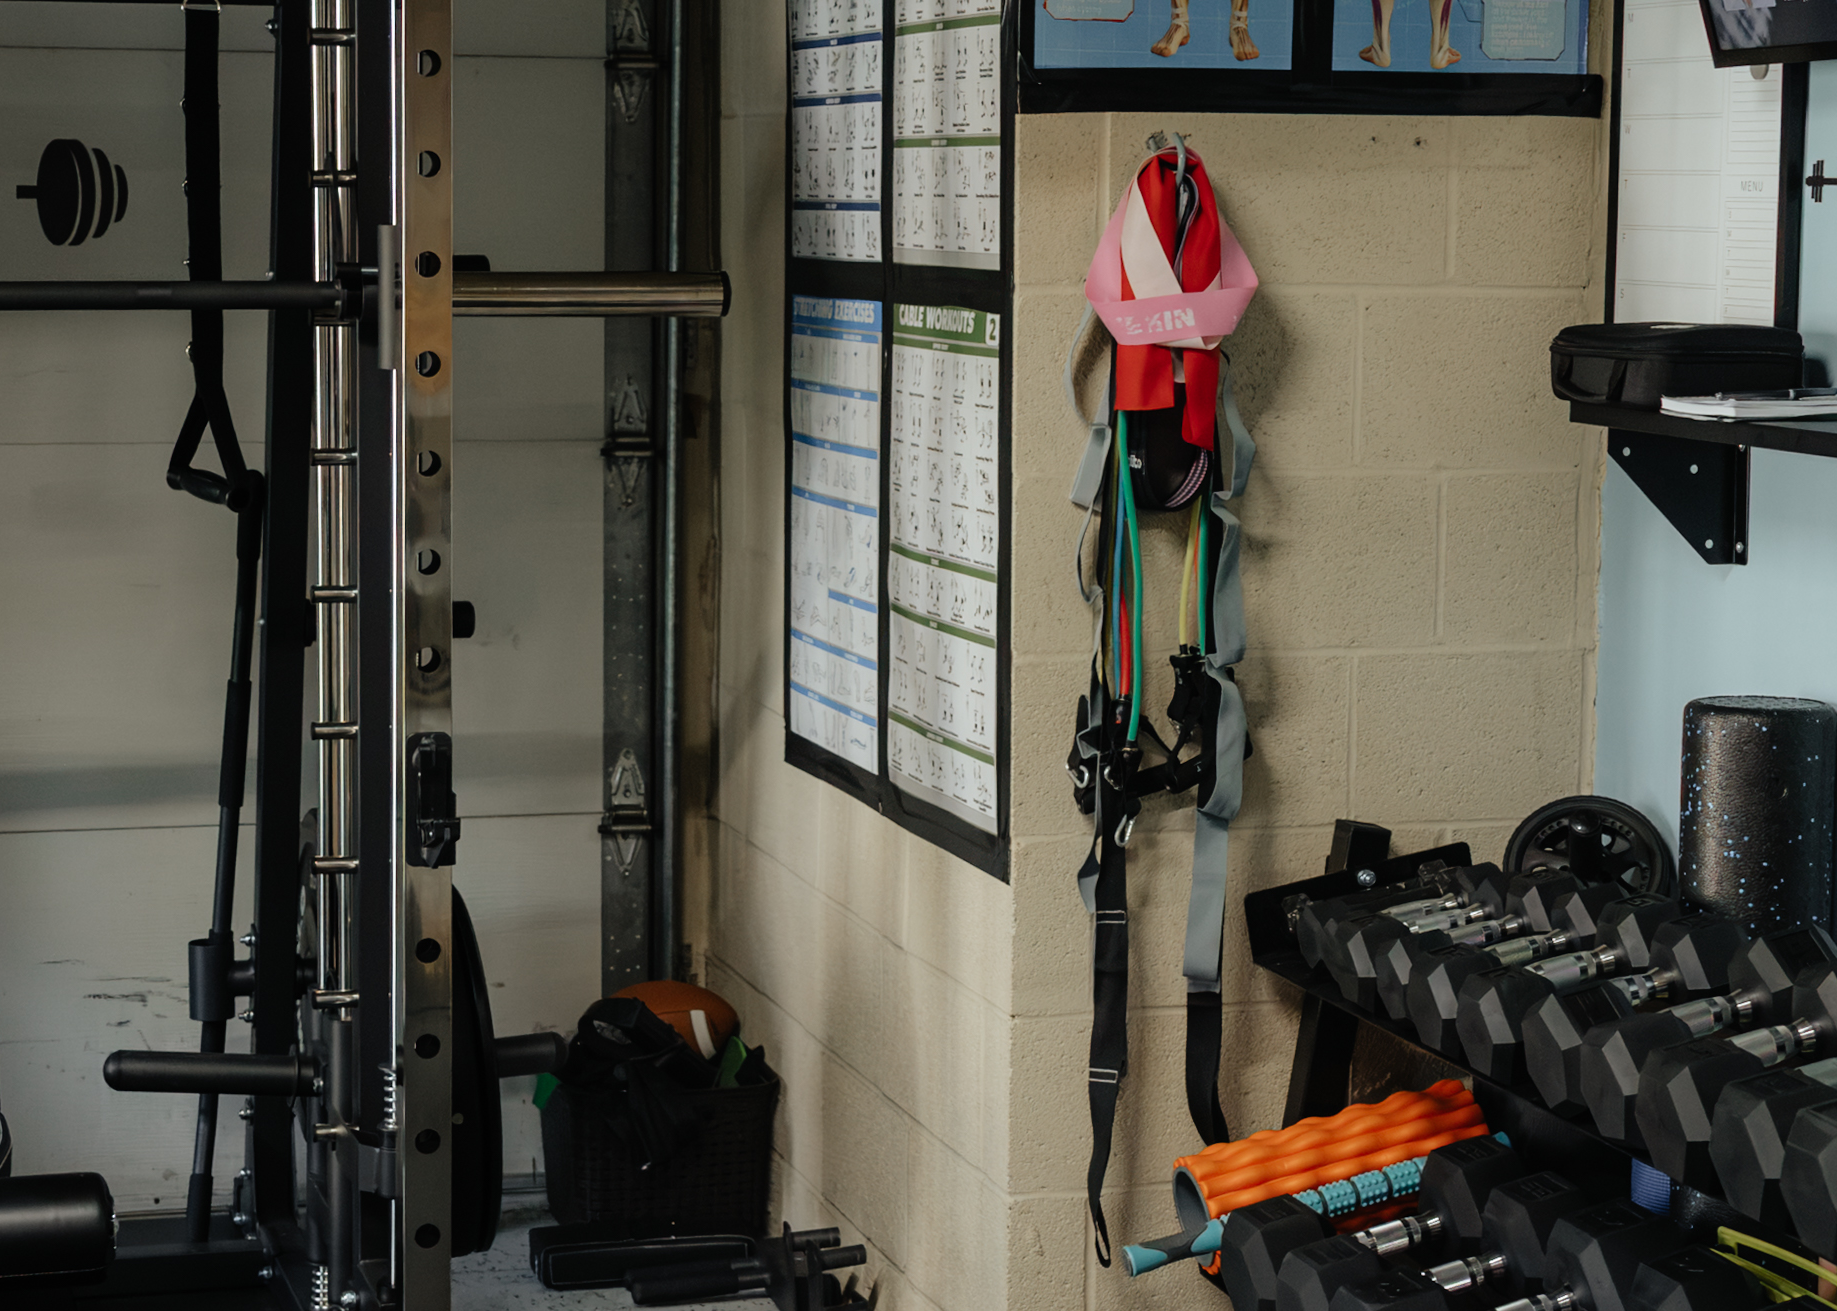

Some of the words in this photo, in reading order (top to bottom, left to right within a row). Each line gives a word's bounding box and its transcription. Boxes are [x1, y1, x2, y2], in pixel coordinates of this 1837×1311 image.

[1740, 180, 1764, 193] MENU
[899, 304, 924, 328] CABLE
[926, 305, 976, 334] WORKOUTS
[989, 318, 996, 341] 2
